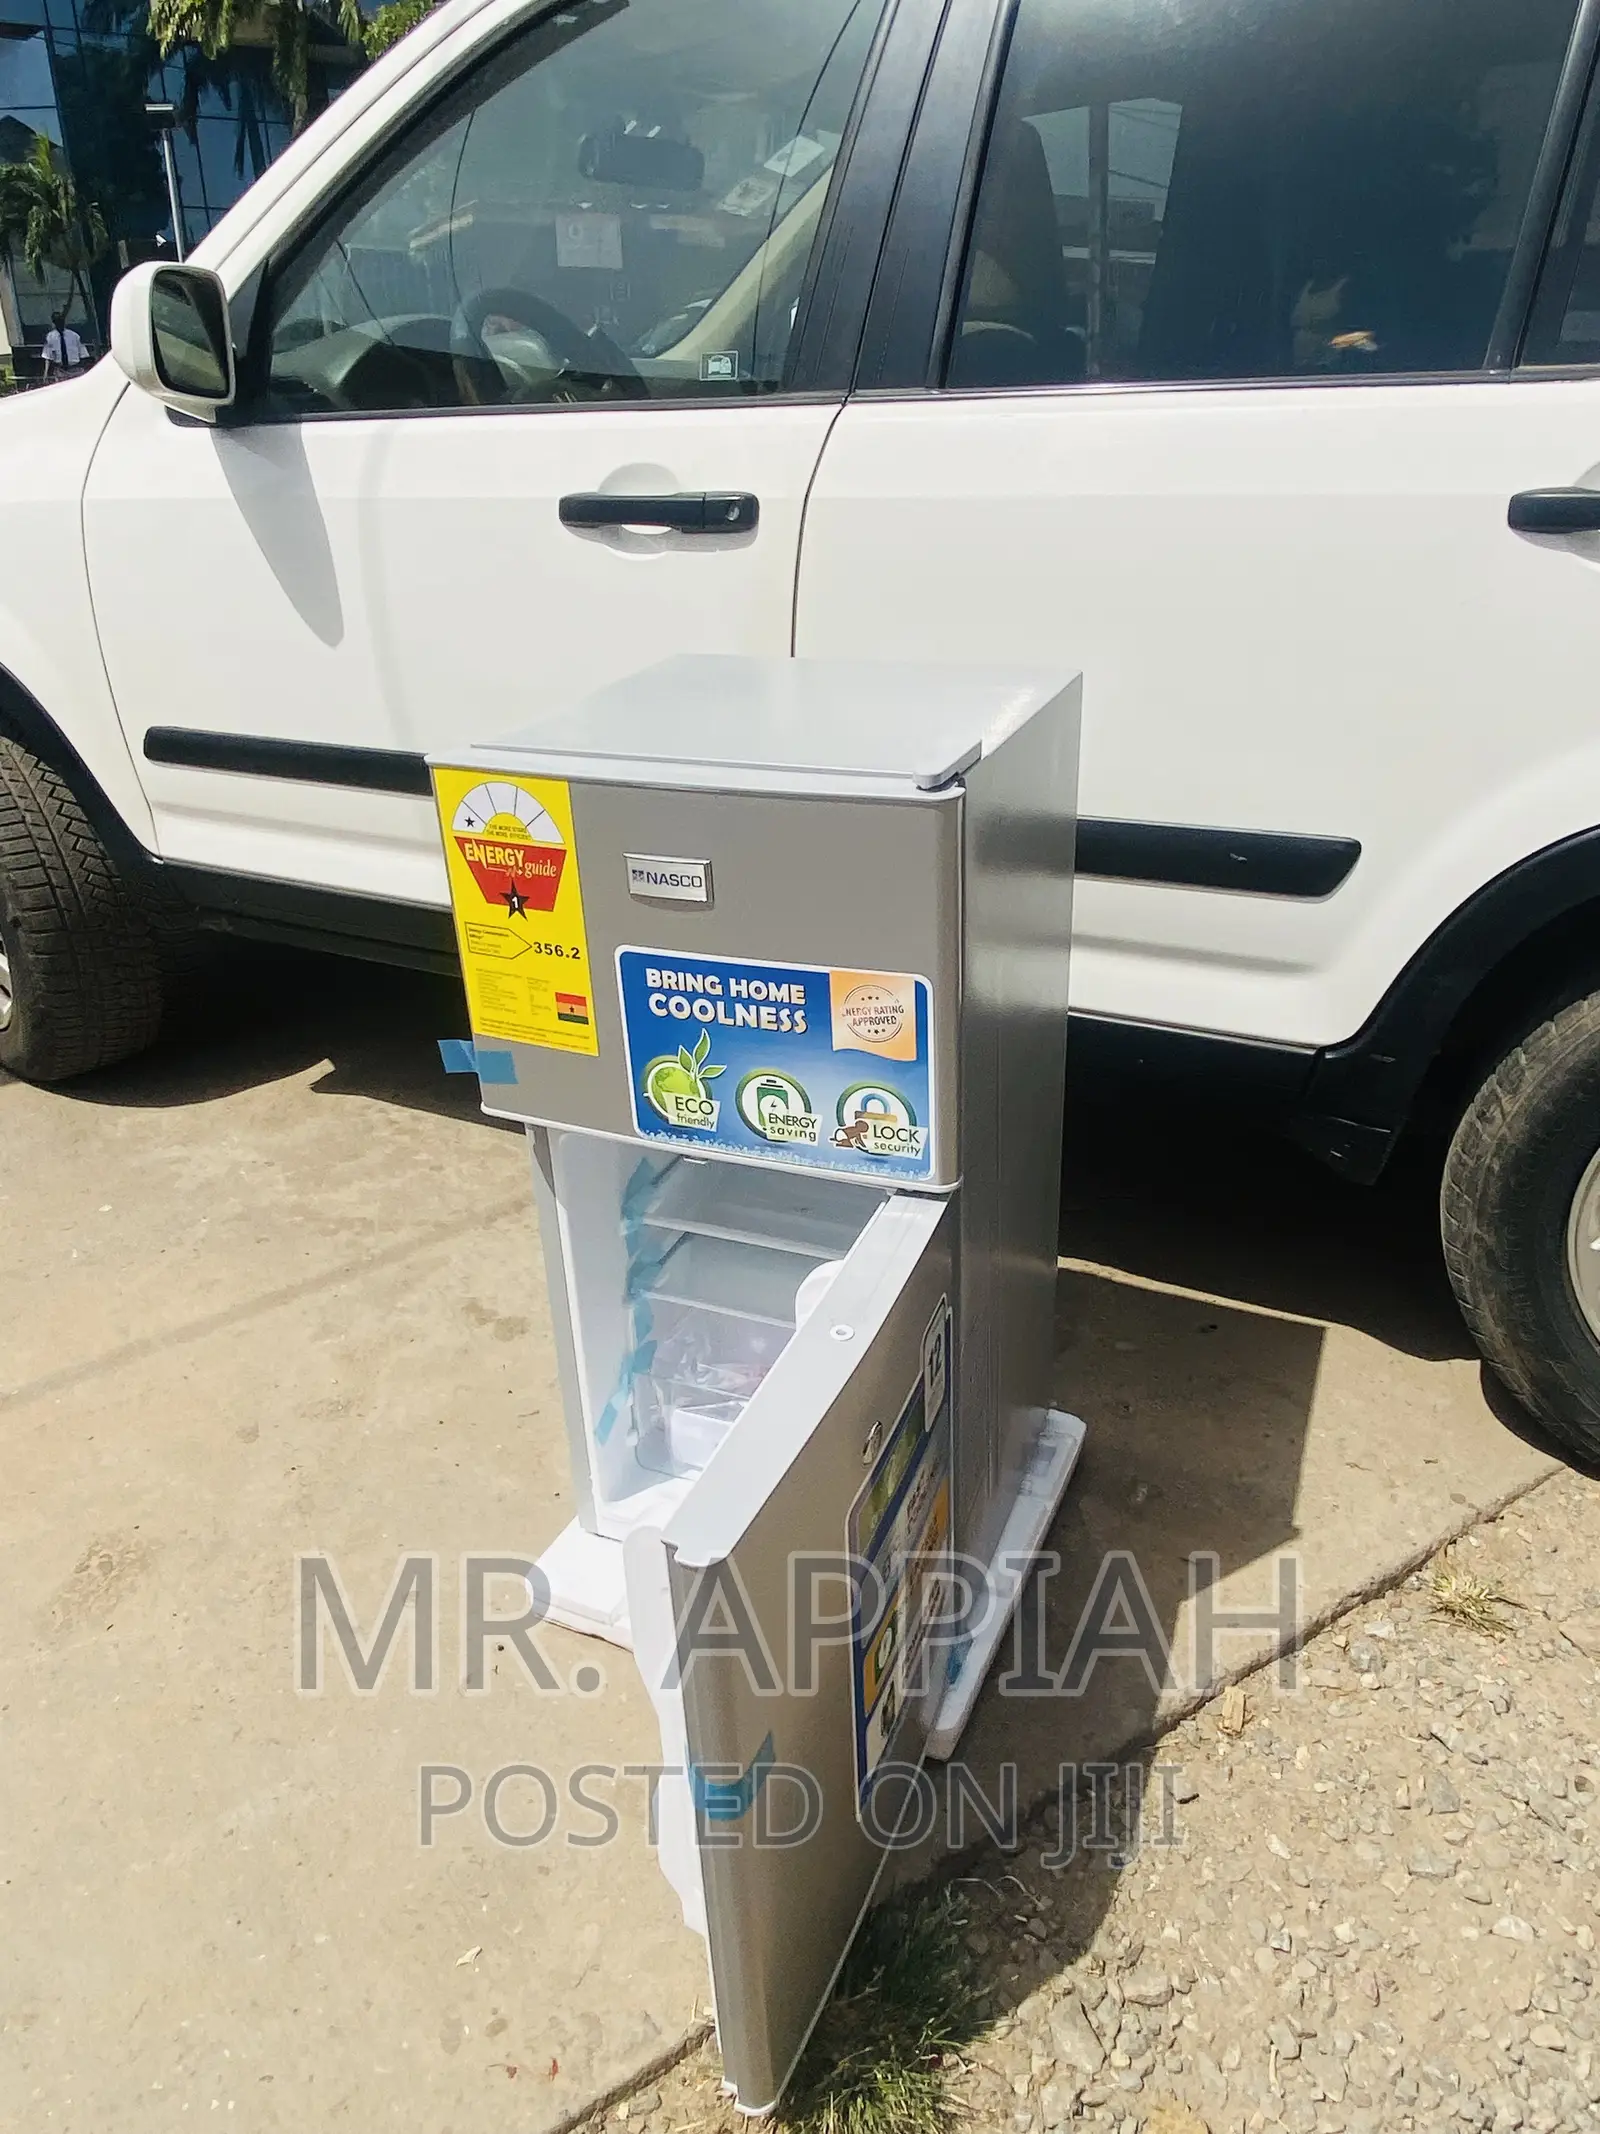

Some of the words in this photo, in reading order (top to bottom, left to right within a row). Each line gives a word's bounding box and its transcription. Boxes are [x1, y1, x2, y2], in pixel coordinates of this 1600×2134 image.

[465, 840, 524, 868] ENERGY
[524, 860, 557, 878] guide
[646, 871, 703, 888] NASCO
[511, 896, 518, 909] 1
[533, 941, 581, 960] 356.2
[645, 968, 723, 996] BRING
[729, 977, 806, 1005] HOME
[648, 994, 808, 1034] COOLNESS
[873, 1004, 905, 1015] RATING
[852, 1015, 897, 1027] APPROVED
[675, 1095, 714, 1116] ECO
[676, 1113, 715, 1129] friendly
[768, 1114, 817, 1129] ENERGY
[770, 1126, 817, 1142] saving
[873, 1123, 919, 1144] LOCK
[873, 1141, 921, 1155] security
